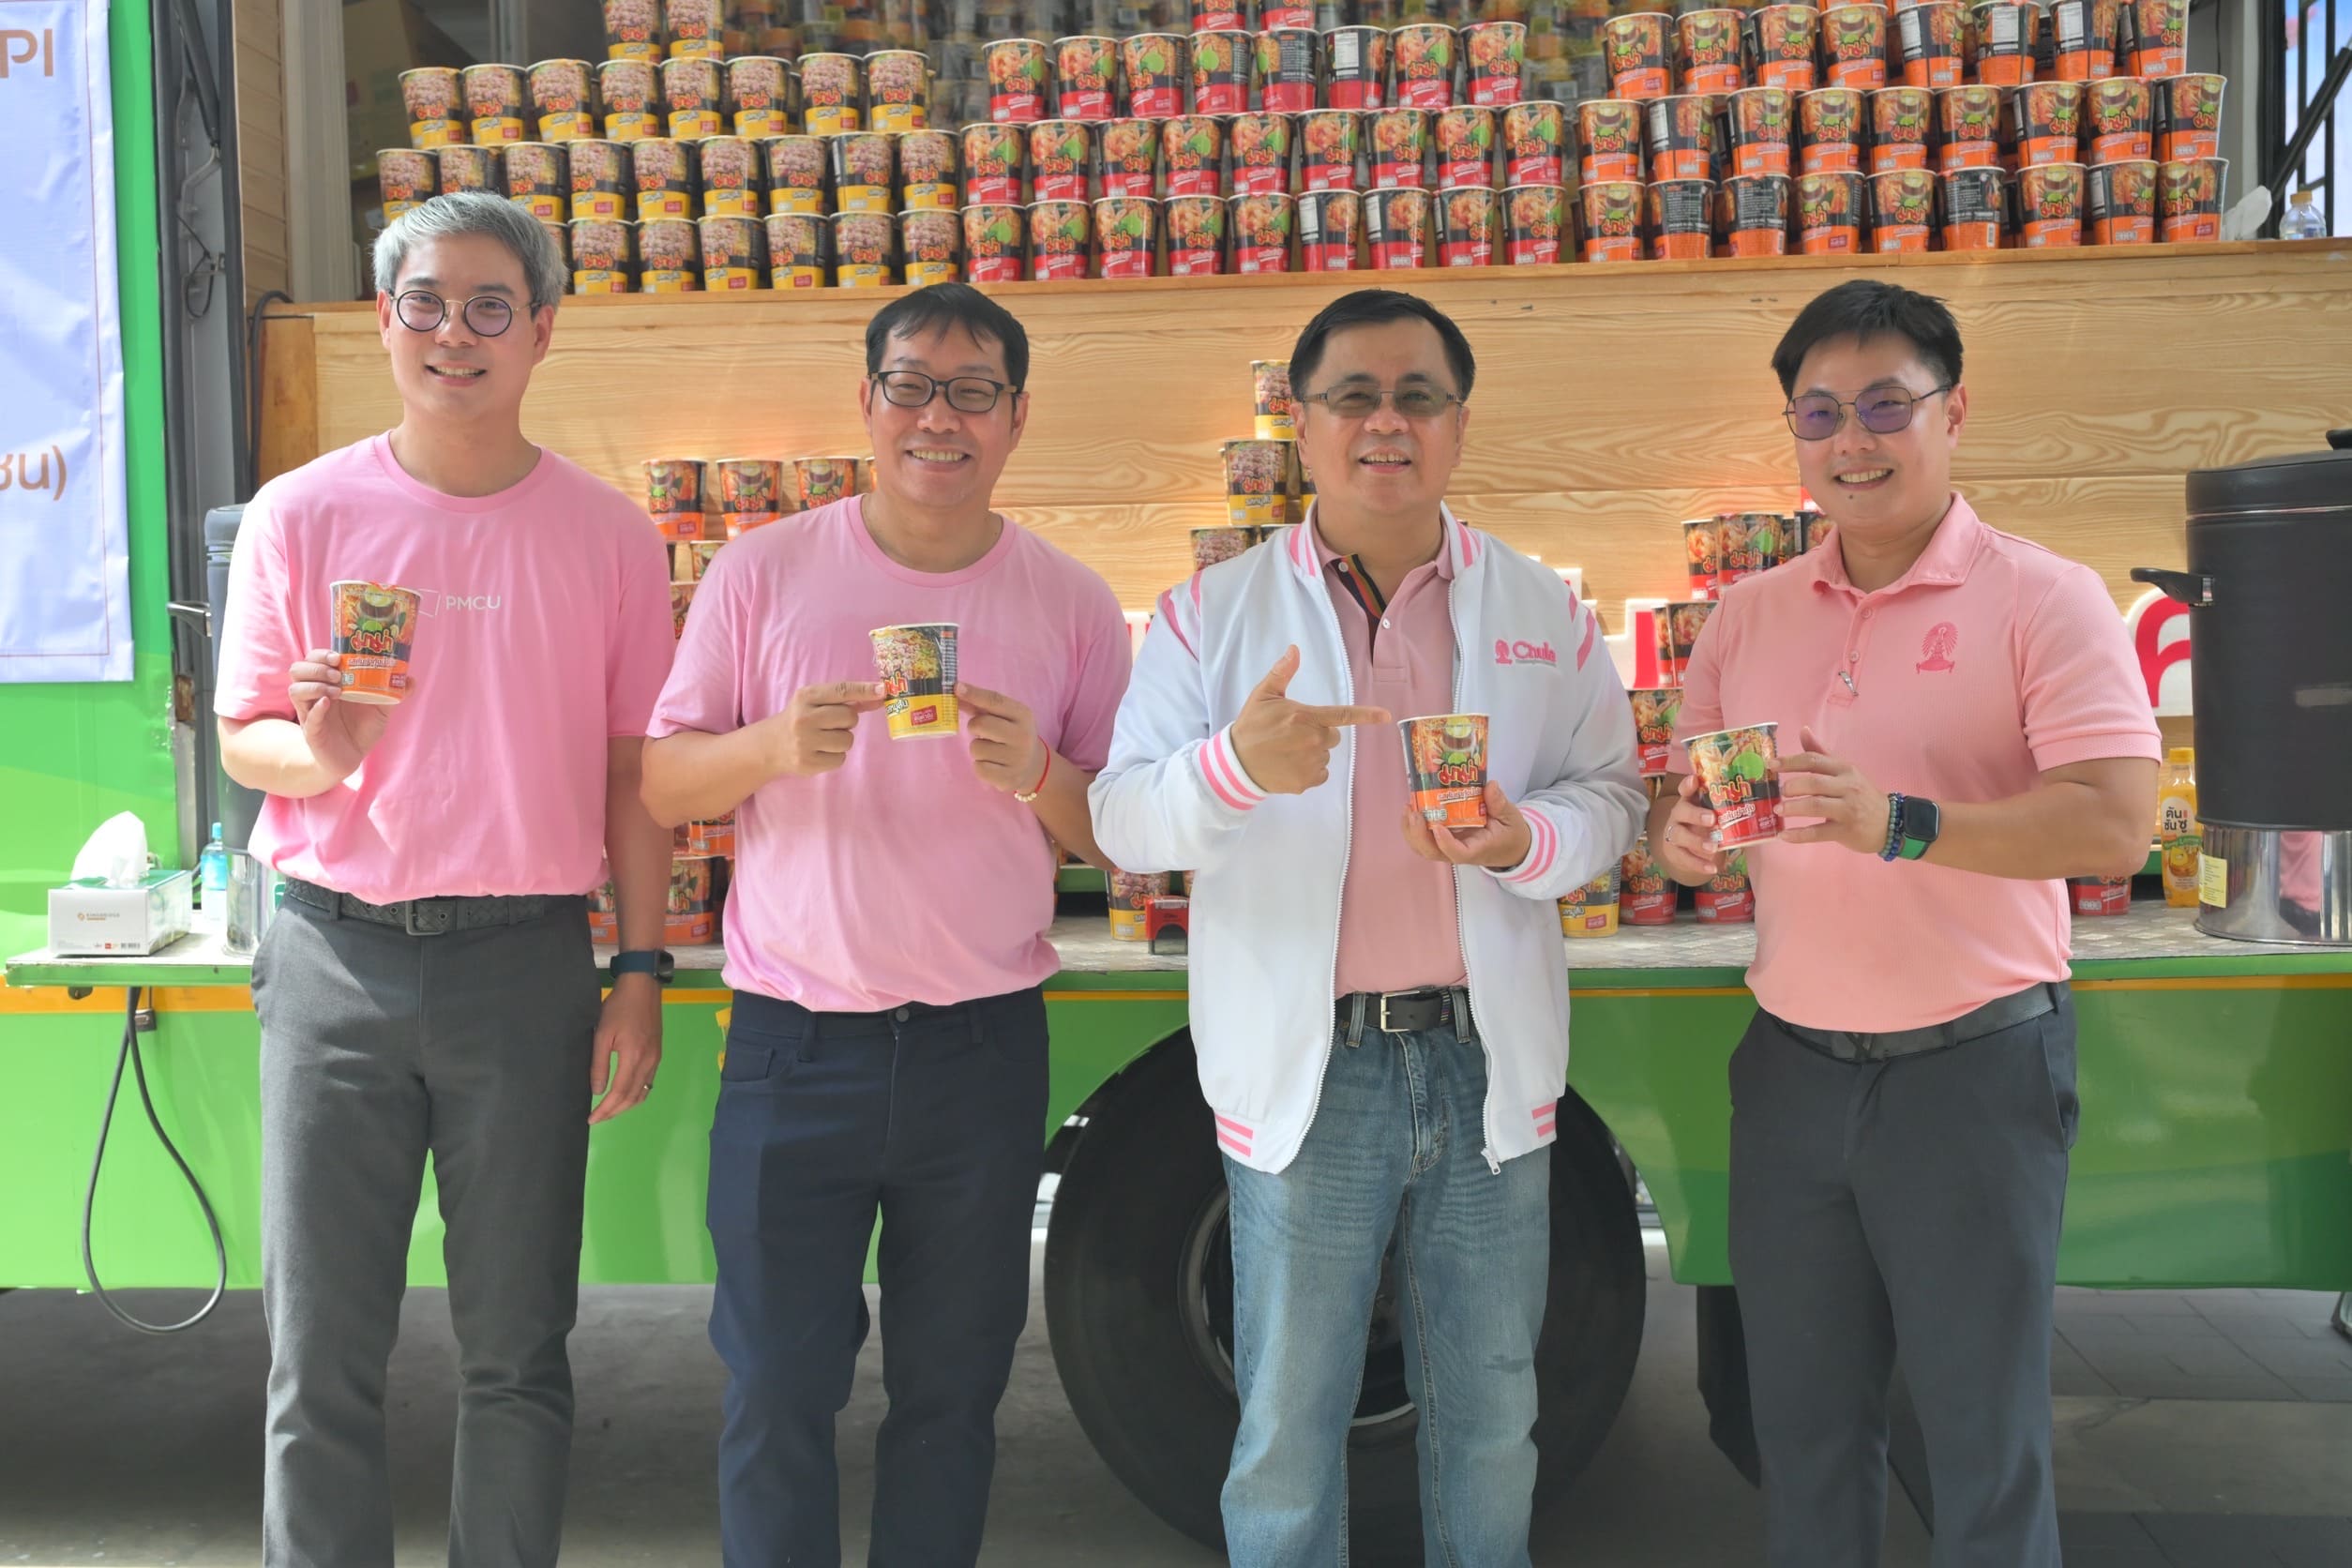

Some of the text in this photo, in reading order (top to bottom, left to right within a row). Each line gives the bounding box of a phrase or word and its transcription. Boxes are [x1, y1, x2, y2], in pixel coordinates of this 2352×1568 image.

[445, 596, 502, 610] PMCU
[351, 629, 394, 654] มาม่า
[1513, 640, 1557, 663] Chula
[884, 671, 909, 697] าม่า
[1438, 758, 1478, 785] มาม่า
